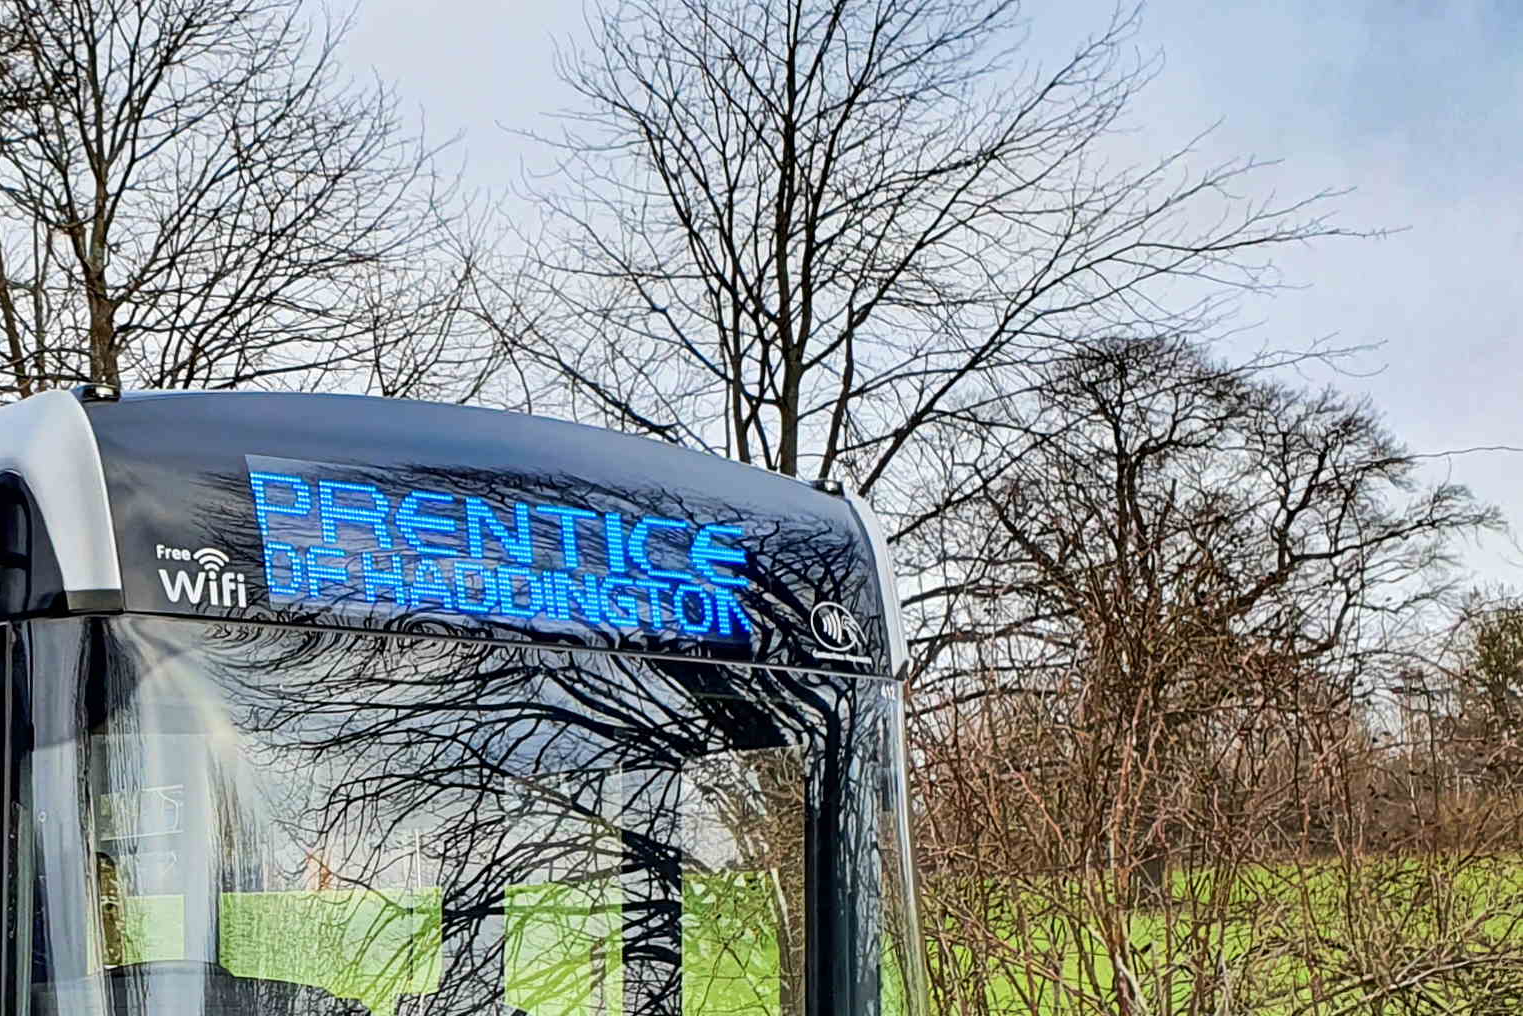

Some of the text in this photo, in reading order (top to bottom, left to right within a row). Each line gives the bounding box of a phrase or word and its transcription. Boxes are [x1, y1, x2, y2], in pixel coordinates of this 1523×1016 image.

[156, 544, 191, 561] Free
[250, 472, 750, 588] PRENTICE
[158, 569, 247, 608] Wifi
[265, 541, 753, 635] OF HADDINGTON
